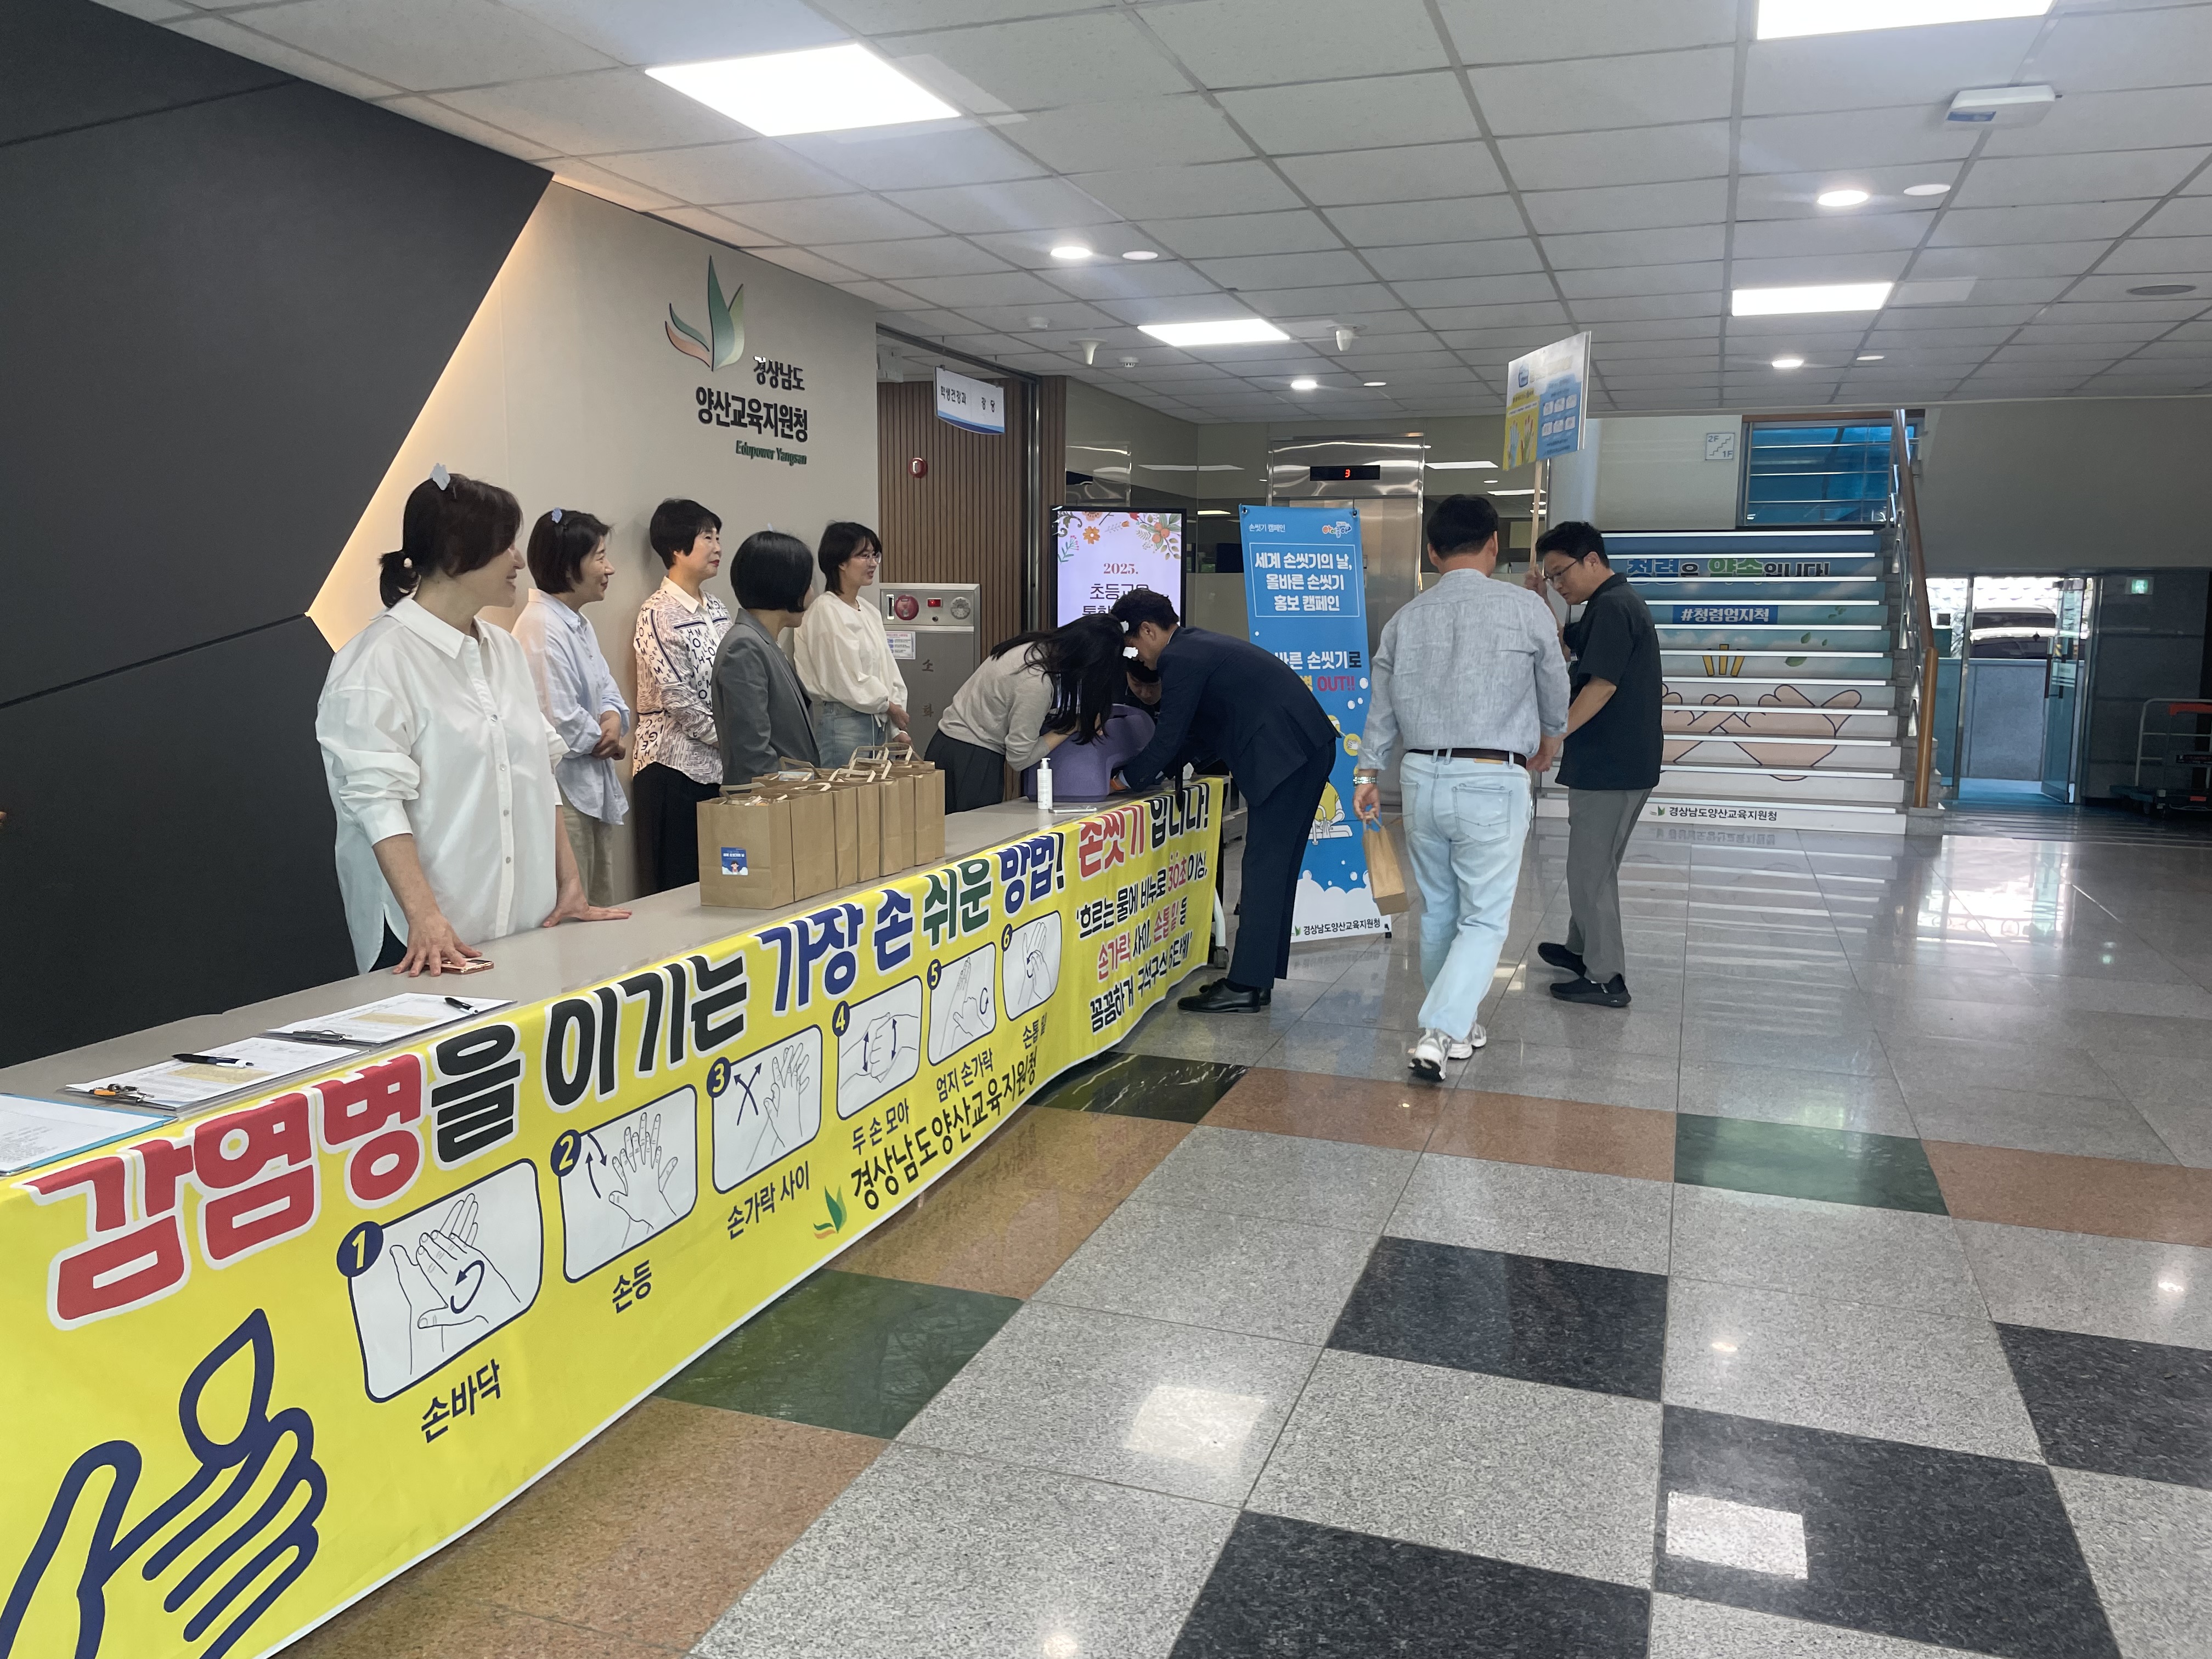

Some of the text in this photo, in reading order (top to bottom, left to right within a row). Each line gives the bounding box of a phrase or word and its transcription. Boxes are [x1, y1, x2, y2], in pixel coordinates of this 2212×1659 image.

[753, 356, 805, 391] 경상남도
[696, 386, 808, 443] 양산교육지원청
[736, 440, 807, 466] Edupower Yangsan
[1345, 469, 1351, 478] 3
[1268, 524, 1285, 532] 캠페인
[1103, 563, 1138, 574] 2025.
[1255, 552, 1352, 571] 세계 손씻기의 날,
[1266, 574, 1344, 590] 올바른 손씻기
[1274, 595, 1340, 611] 홍보 캠페인
[1680, 608, 1769, 622] #청렴엄지척
[1274, 651, 1362, 669] 바른 손씻기로
[1317, 676, 1355, 692] OUT!!
[1669, 806, 1777, 821] 경상남도양산교육지원청
[1116, 883, 1138, 923] 물에
[1141, 868, 1166, 909] 비누로
[1003, 926, 1010, 949] 6
[1098, 932, 1131, 980] 손가락
[1180, 896, 1187, 926] 등
[1304, 918, 1380, 935] 경상남도양산교육지원청
[930, 963, 938, 986] 5
[835, 1004, 845, 1031] 4
[1090, 975, 1134, 1033] 꼼꼼하게
[24, 1025, 521, 1321] 감염병을
[546, 955, 748, 1106] 이기는
[758, 902, 864, 1012] 가장
[923, 859, 992, 946] 쉬운
[992, 832, 1064, 915] 방법!
[1077, 804, 1144, 878] 손씻기
[1144, 782, 1210, 849] 입니다!
[712, 1061, 726, 1095] 3
[936, 1047, 994, 1103] 엄지 손가락
[851, 1045, 1038, 1210] 경상남도양산교육지원청
[852, 1098, 910, 1155] 두 손 모아
[557, 1137, 575, 1173] 2
[726, 1160, 810, 1240] 손가락 사이
[351, 1230, 366, 1269] 1
[612, 1260, 652, 1314] 손등
[421, 1358, 501, 1443] 손바닥
